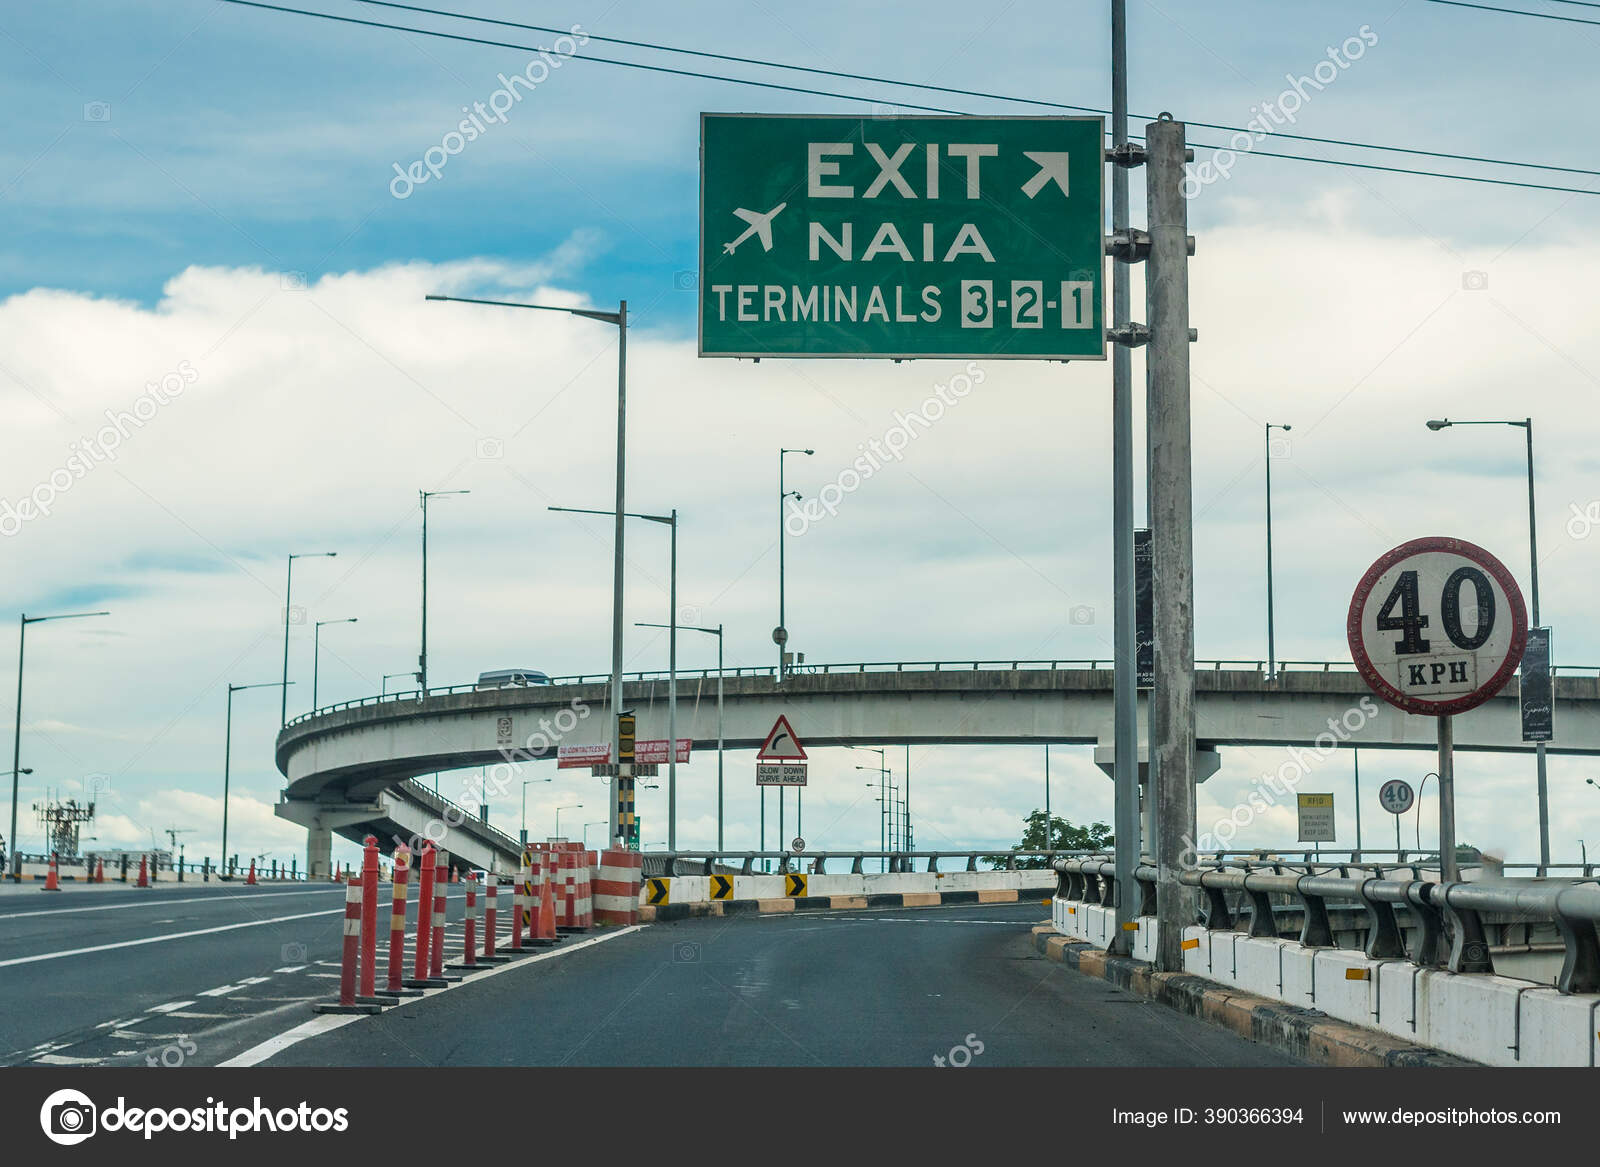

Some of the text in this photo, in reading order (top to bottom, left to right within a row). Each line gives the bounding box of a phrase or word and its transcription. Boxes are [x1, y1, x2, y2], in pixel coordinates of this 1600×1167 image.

[807, 142, 999, 200] EXIT
[808, 222, 996, 263] NAIA
[711, 284, 942, 323] TERMINALS
[1376, 565, 1497, 656] 40
[1407, 661, 1469, 686] KPH
[760, 775, 805, 783] CURVE AHEAD
[1384, 785, 1409, 802] 40
